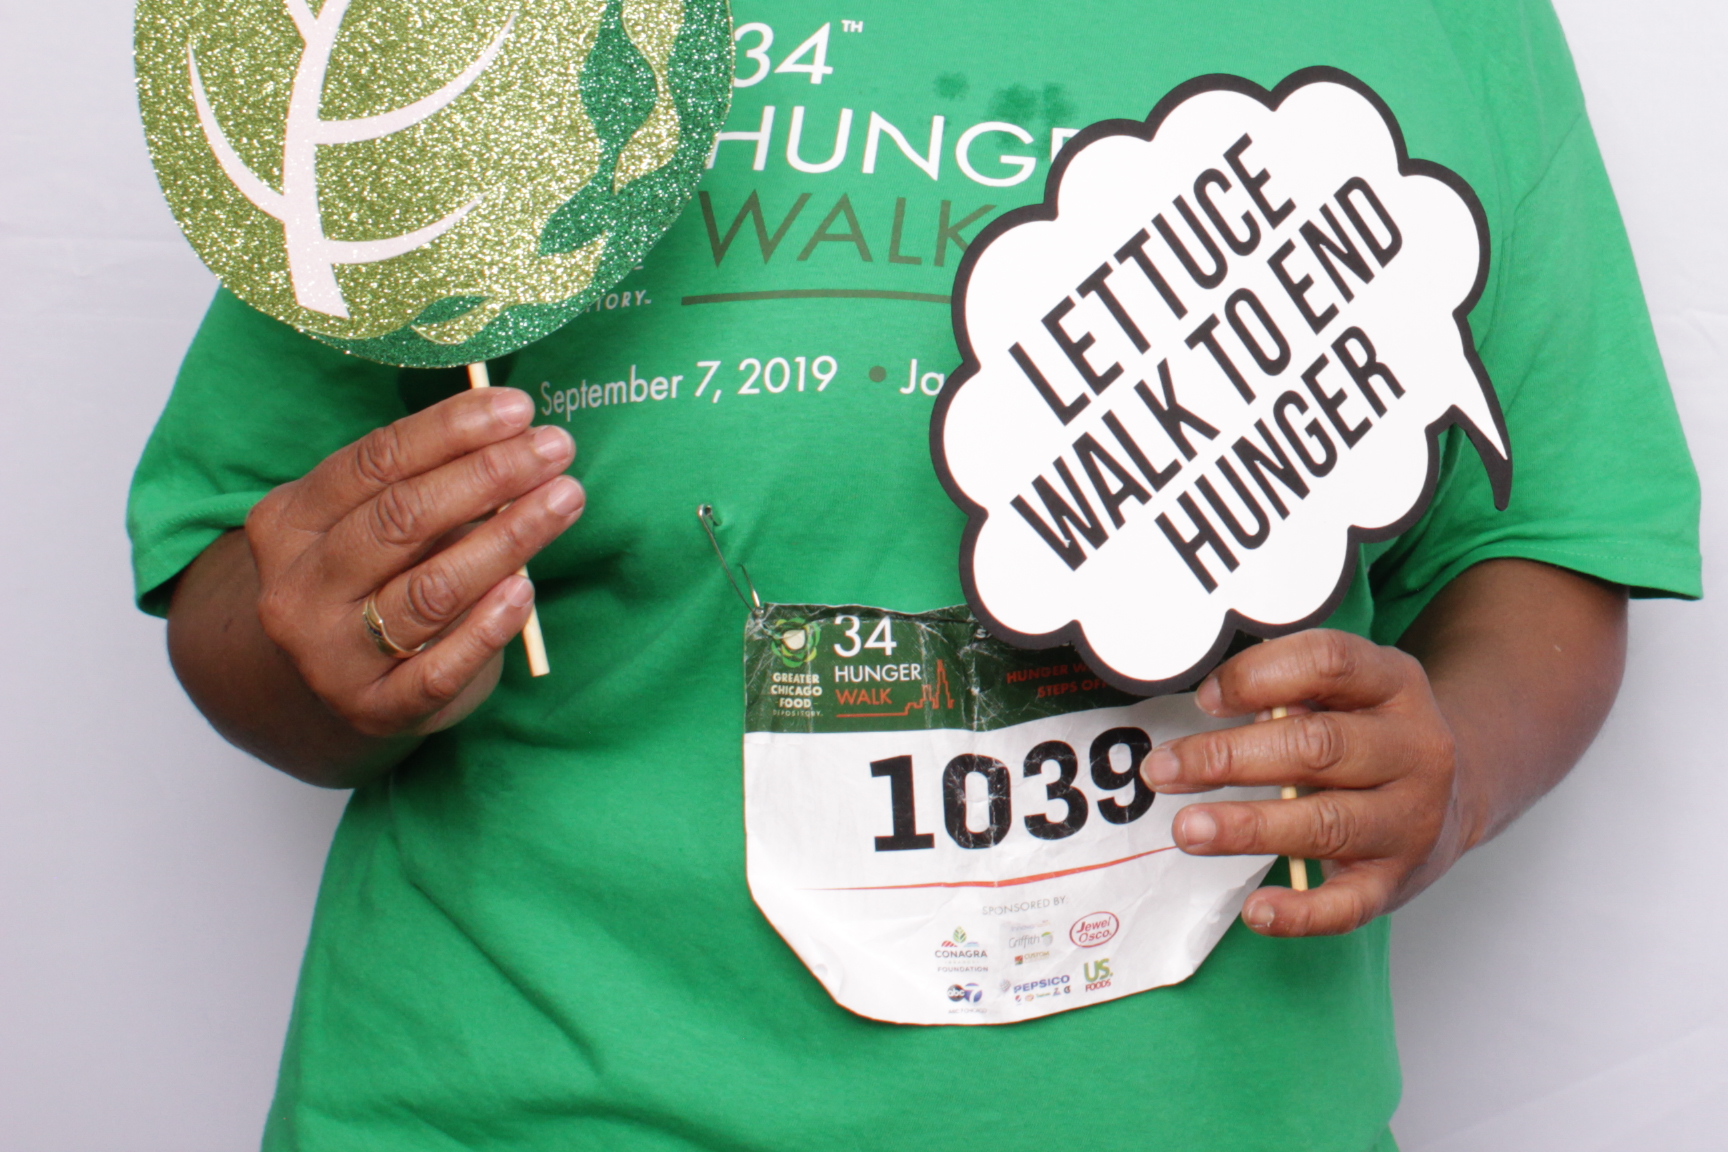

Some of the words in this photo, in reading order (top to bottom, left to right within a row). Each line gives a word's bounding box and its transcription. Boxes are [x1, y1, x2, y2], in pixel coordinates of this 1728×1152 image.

[698, 189, 997, 268] WALK
[1008, 132, 1297, 426] LETTUCE
[1009, 357, 1222, 572] WALK
[1184, 287, 1292, 405] TO
[1266, 176, 1403, 335] END
[541, 364, 684, 422] September
[694, 360, 723, 404] 7,
[737, 355, 839, 395] 2019
[1153, 325, 1406, 594] HUNGER
[833, 615, 898, 658] 34
[772, 672, 820, 684] GREATER
[834, 663, 922, 683] HUNGER
[1006, 664, 1069, 685] HUNGER
[770, 685, 823, 696] CHICAGO
[835, 688, 893, 705] WALK
[1037, 681, 1078, 699] STEPS
[779, 698, 812, 708] FOOD
[869, 726, 1158, 853] 1039
[982, 898, 1051, 916] SPONSORED
[1076, 916, 1112, 934] Jewel
[934, 949, 988, 958] CONAGRA
[1013, 974, 1071, 994] PEPSICO
[1085, 978, 1112, 993] FOODS
